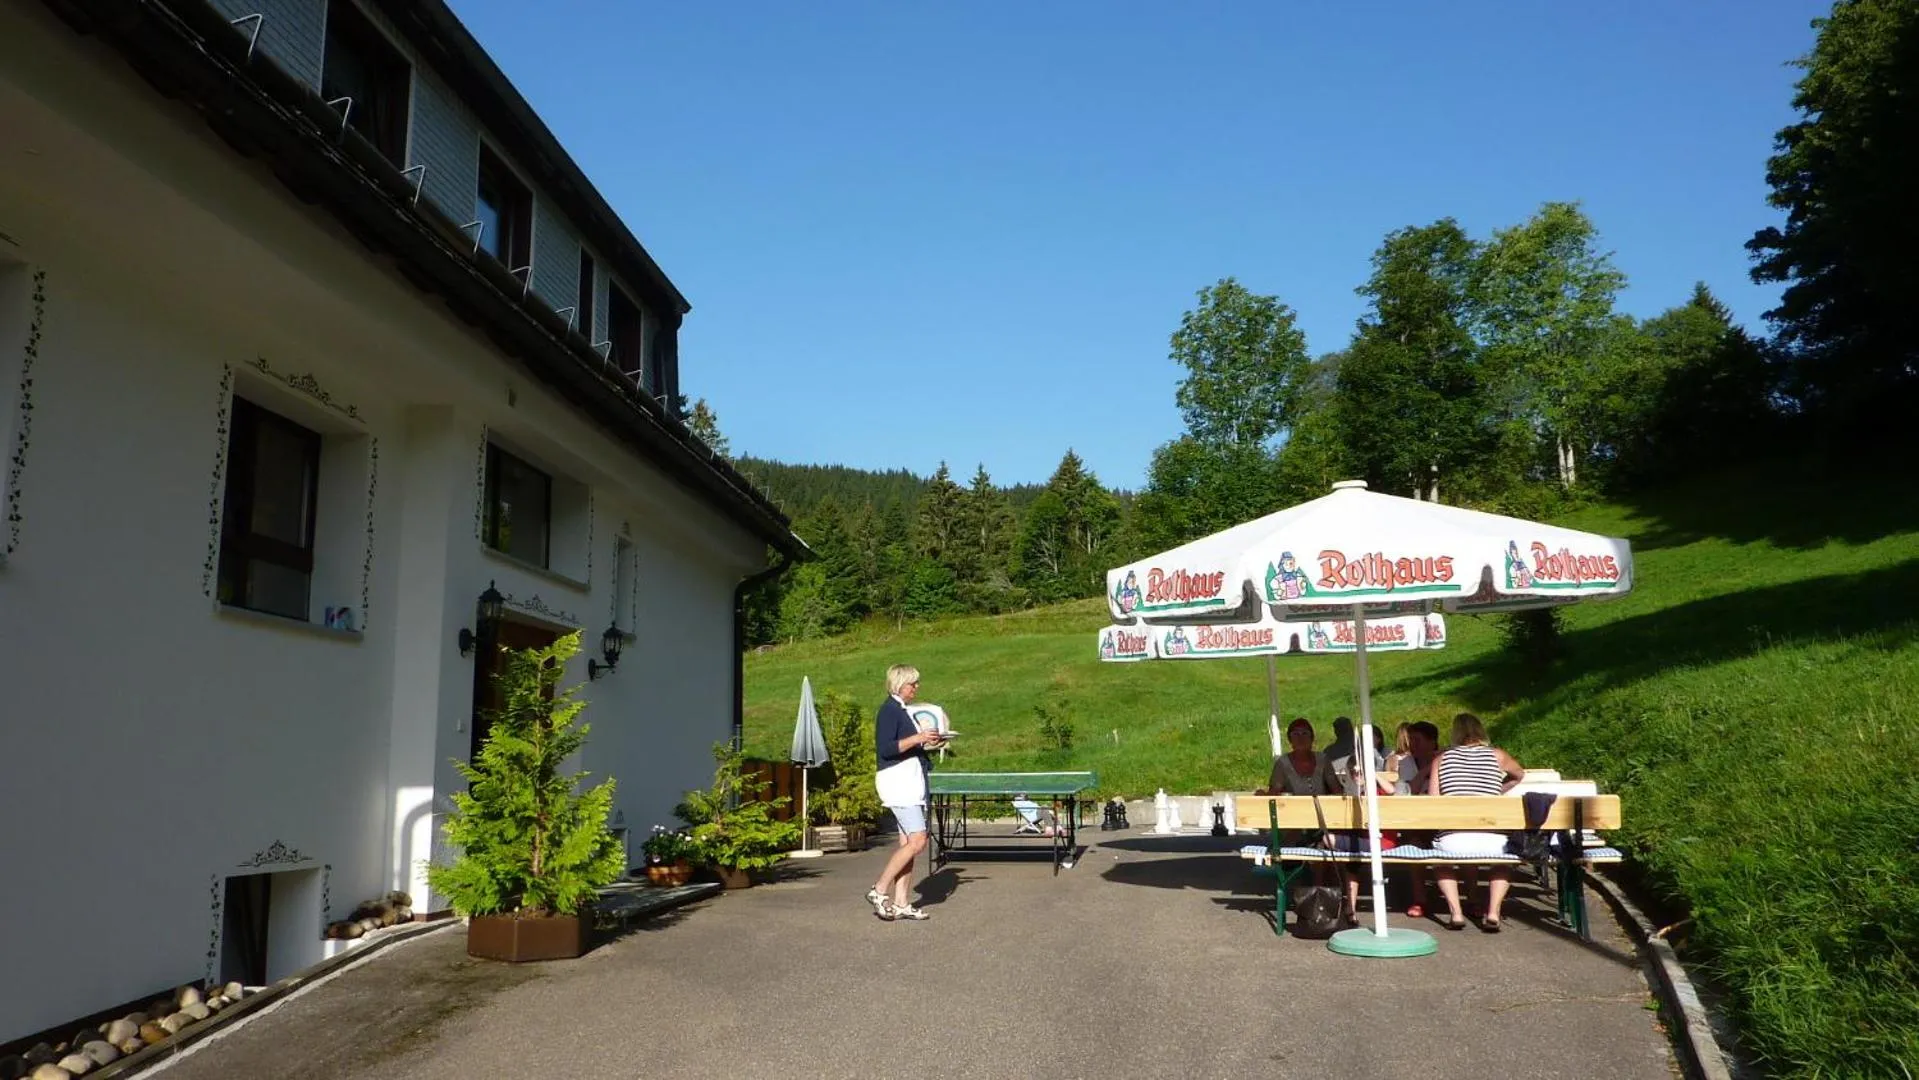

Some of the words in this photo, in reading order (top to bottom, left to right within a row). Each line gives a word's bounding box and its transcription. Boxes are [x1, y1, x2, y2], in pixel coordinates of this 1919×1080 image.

[1317, 550, 1454, 592] Rothaus
[1531, 541, 1619, 588] Rothaus
[1146, 568, 1225, 603] Rothaus
[1195, 624, 1274, 651] Rothaus
[1332, 619, 1405, 644] Rohaus
